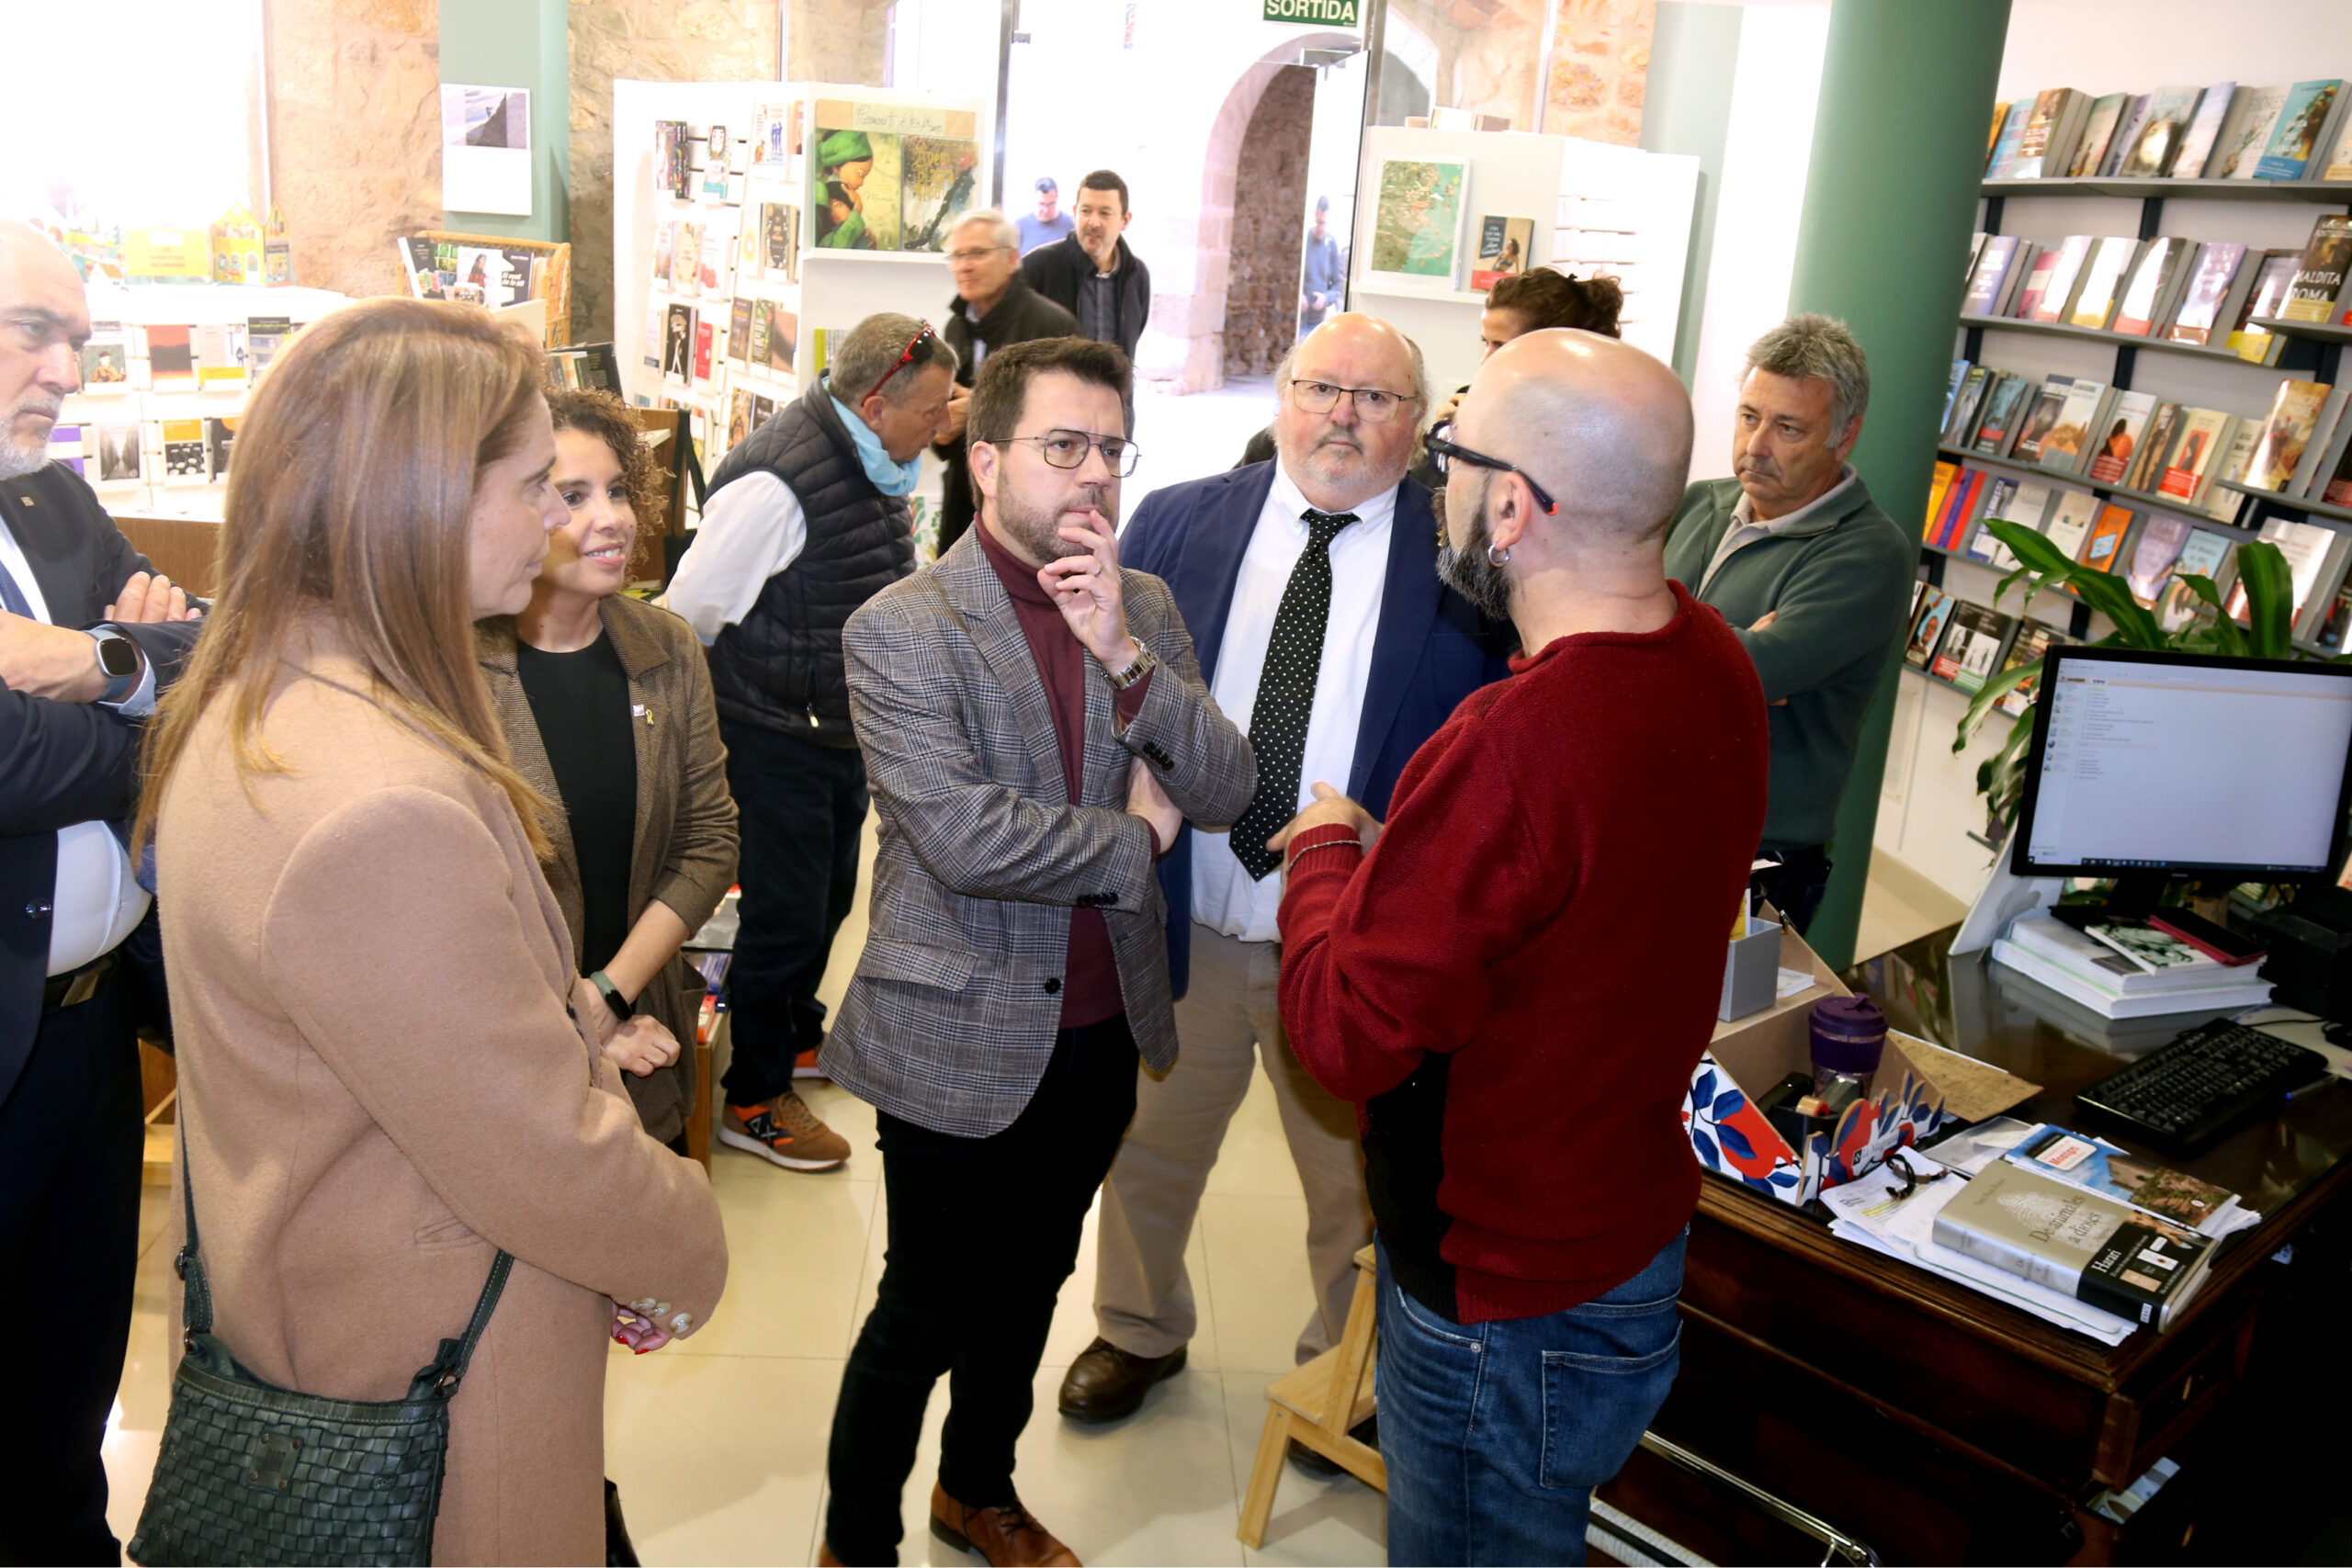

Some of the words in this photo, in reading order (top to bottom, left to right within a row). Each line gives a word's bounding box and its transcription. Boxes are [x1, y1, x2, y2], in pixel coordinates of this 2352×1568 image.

[1266, 0, 1355, 21] SORTIDA
[2297, 269, 2341, 286] MALDITA
[2029, 1225, 2051, 1244] De
[2050, 1195, 2086, 1233] animales
[2074, 1211, 2102, 1240] dioses
[2091, 1247, 2122, 1273] Harari
